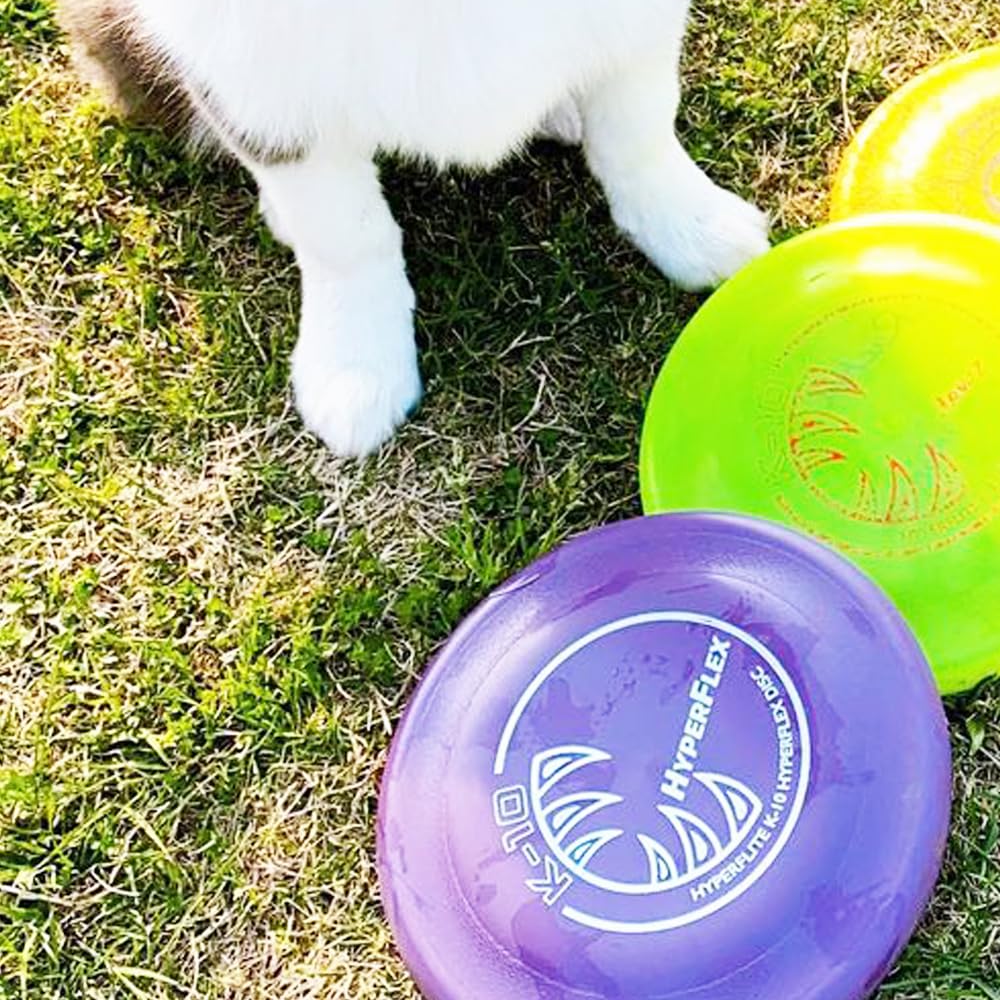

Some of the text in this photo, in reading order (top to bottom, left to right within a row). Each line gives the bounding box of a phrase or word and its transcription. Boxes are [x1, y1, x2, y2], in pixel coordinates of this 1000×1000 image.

[749, 664, 779, 702] DISC
[762, 791, 788, 829] K-10
[492, 784, 573, 906] K-10
[689, 827, 772, 902] HYPERFLITE
